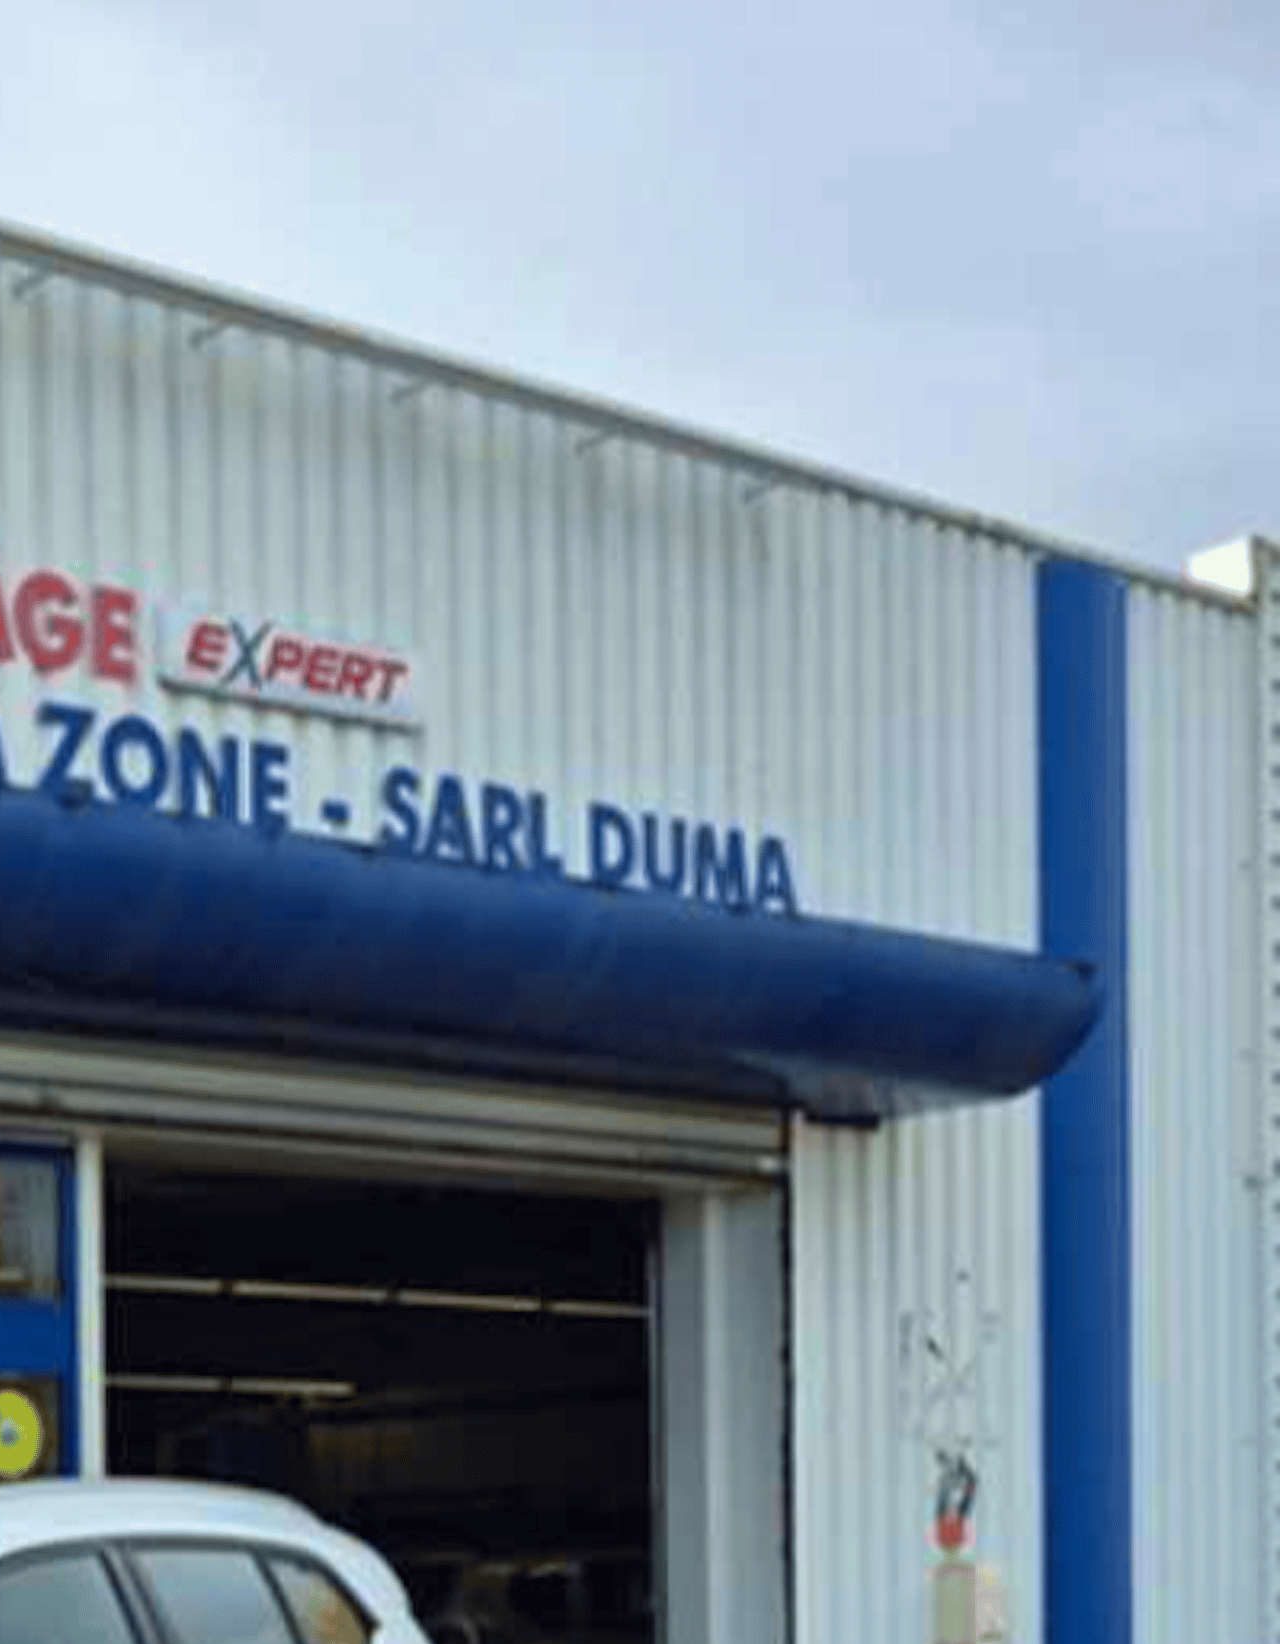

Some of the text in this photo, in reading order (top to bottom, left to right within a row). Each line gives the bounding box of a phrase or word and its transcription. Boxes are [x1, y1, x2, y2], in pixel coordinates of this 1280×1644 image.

[185, 617, 410, 703] EXPERT
[36, 699, 290, 838] ZONE
[381, 766, 565, 880] SARL
[589, 801, 801, 922] DUMA
